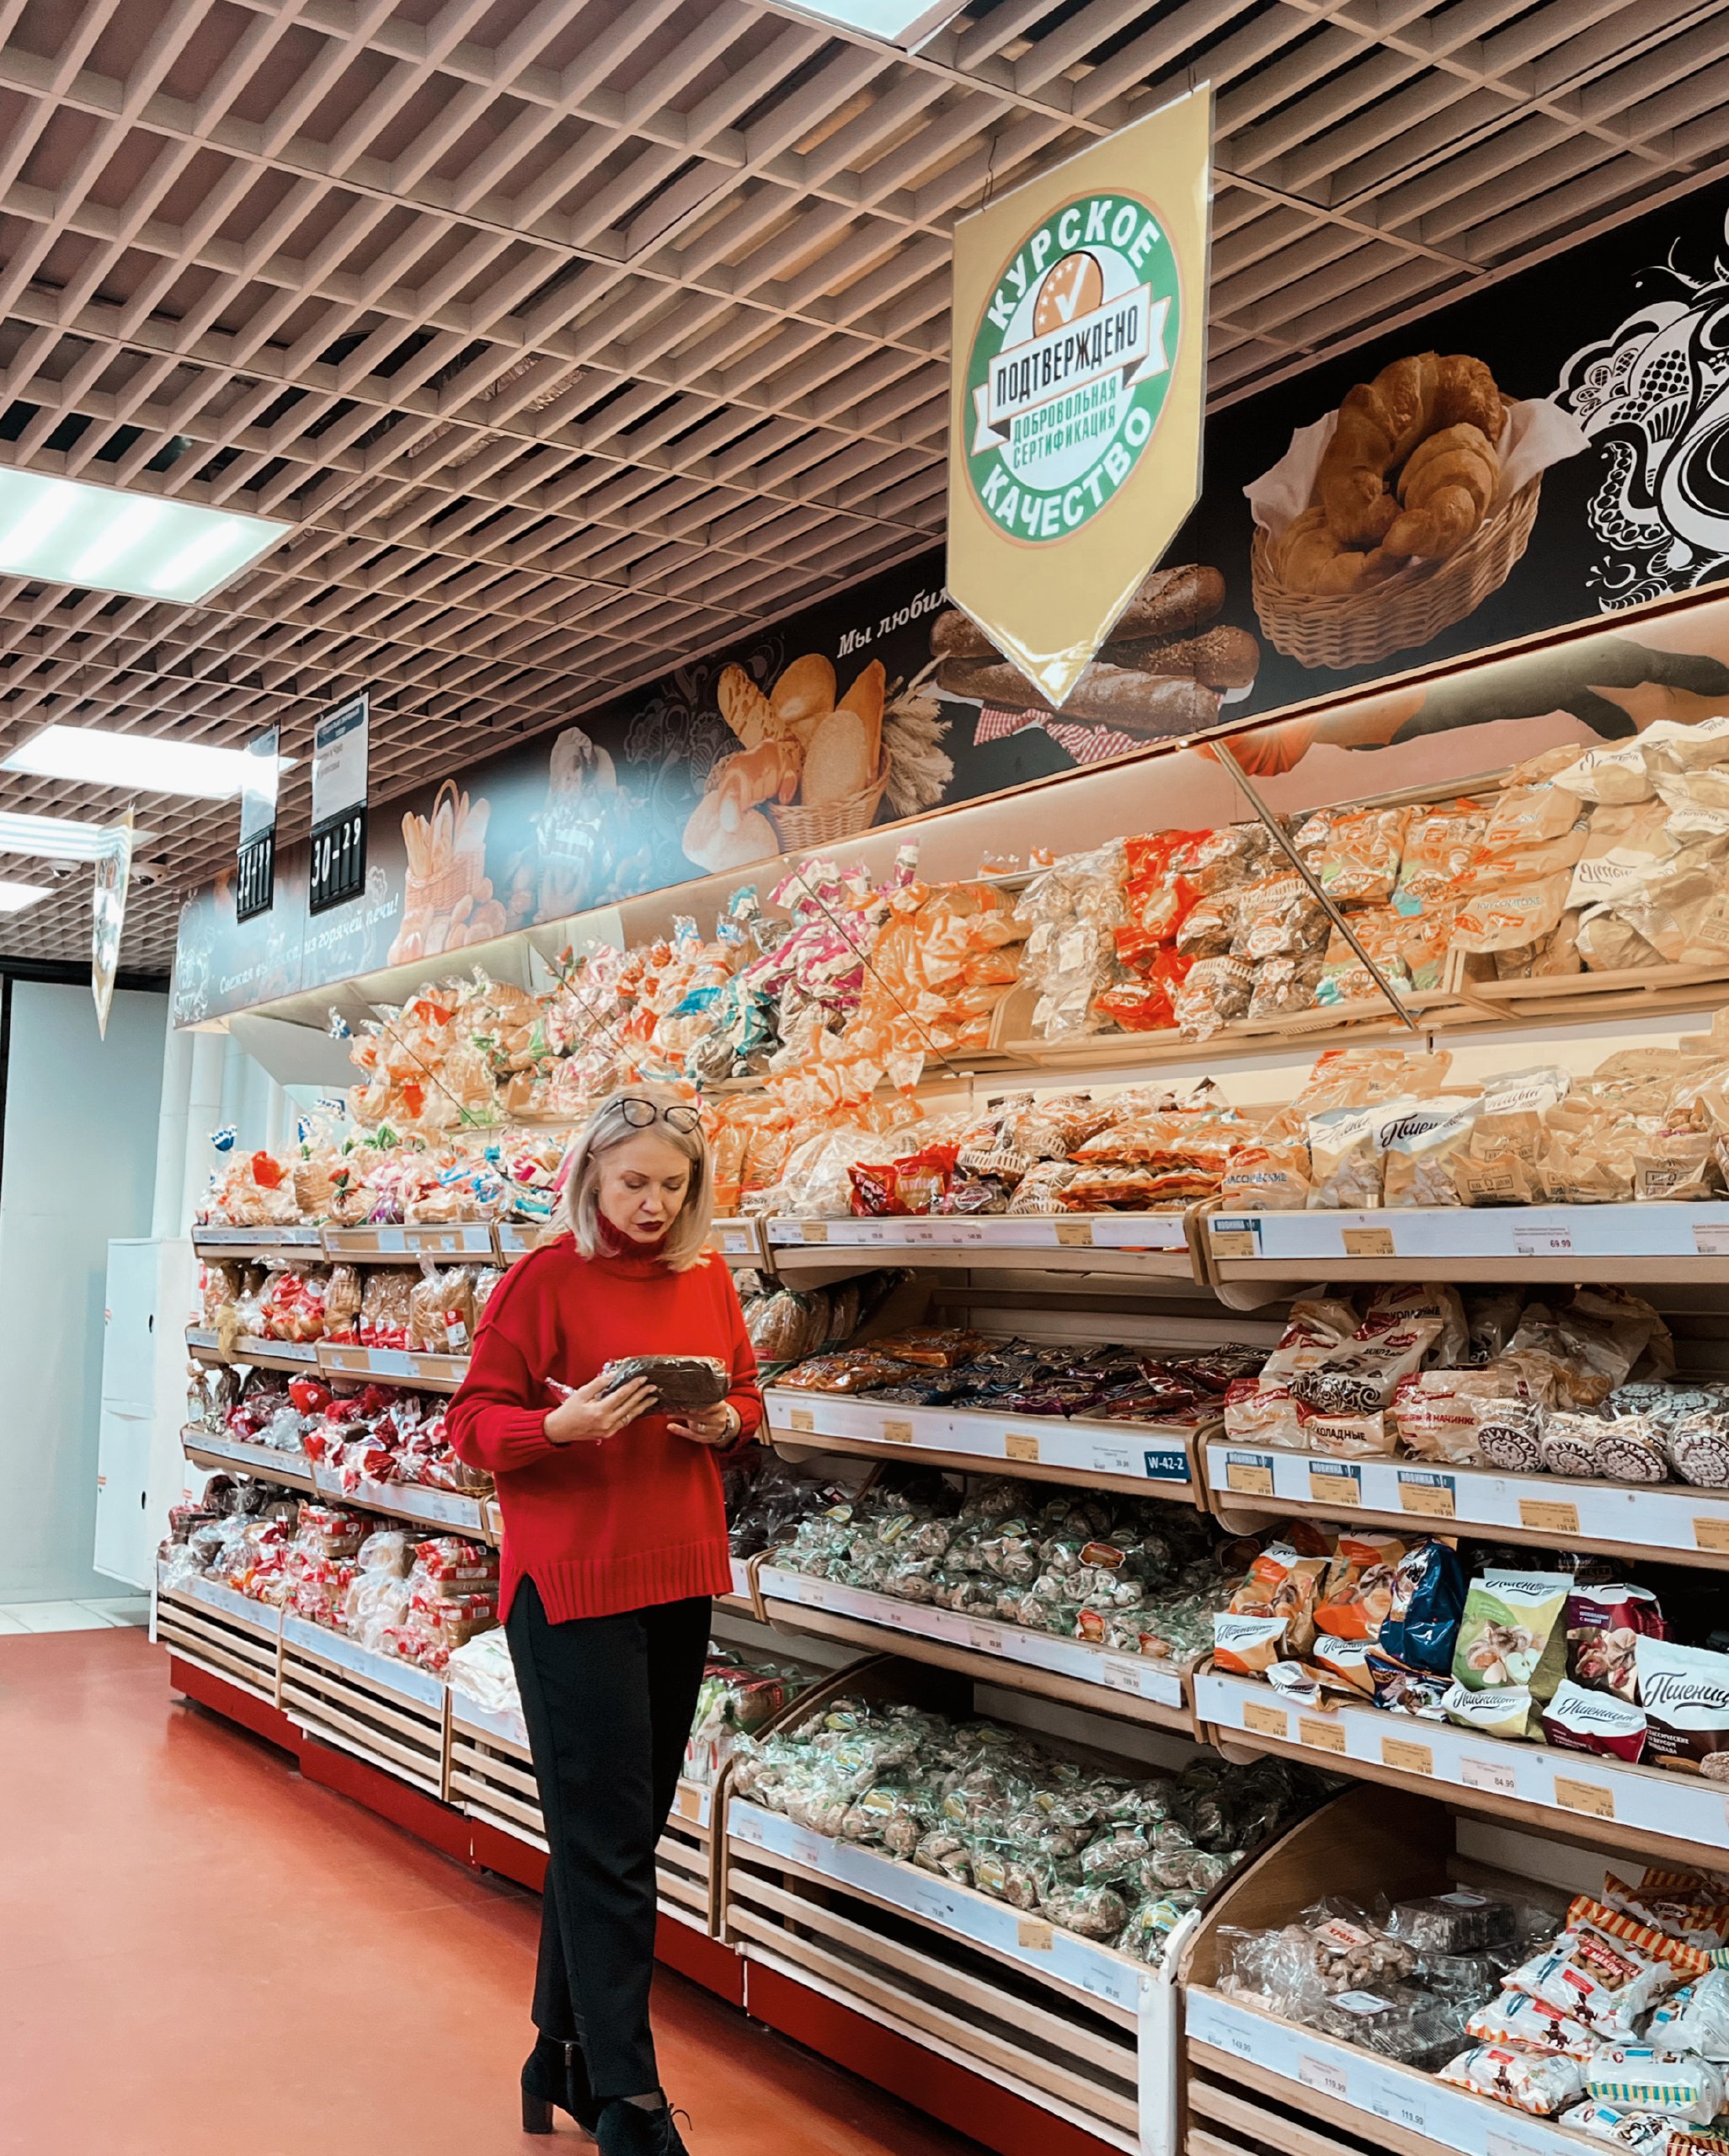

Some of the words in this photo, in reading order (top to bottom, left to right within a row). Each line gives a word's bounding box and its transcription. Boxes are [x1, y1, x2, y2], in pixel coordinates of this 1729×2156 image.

[987, 200, 1161, 331] КУРСКОЕ
[996, 305, 1138, 406] ПОДТВЕРЖДЕНО
[1013, 376, 1117, 446] ДОБРОВОЛЬНАЯ
[1013, 405, 1116, 469] СЕРТИФИКАЦИЯ
[981, 406, 1150, 536] КАЧЕСТВО
[837, 629, 873, 659] Мы
[318, 910, 363, 951] горячей
[366, 893, 399, 927] печи!
[1550, 1239, 1572, 1248] 69.99
[1148, 1456, 1185, 1470] W-42-2
[1643, 1672, 1729, 1712] Пшениц
[1494, 1777, 1515, 1788] 84.99
[1589, 1950, 1624, 1977] МАКОМ
[1612, 1954, 1641, 1977] КРОХА
[1231, 2038, 1251, 2053] 149.99
[1325, 2077, 1347, 2094] 119.99
